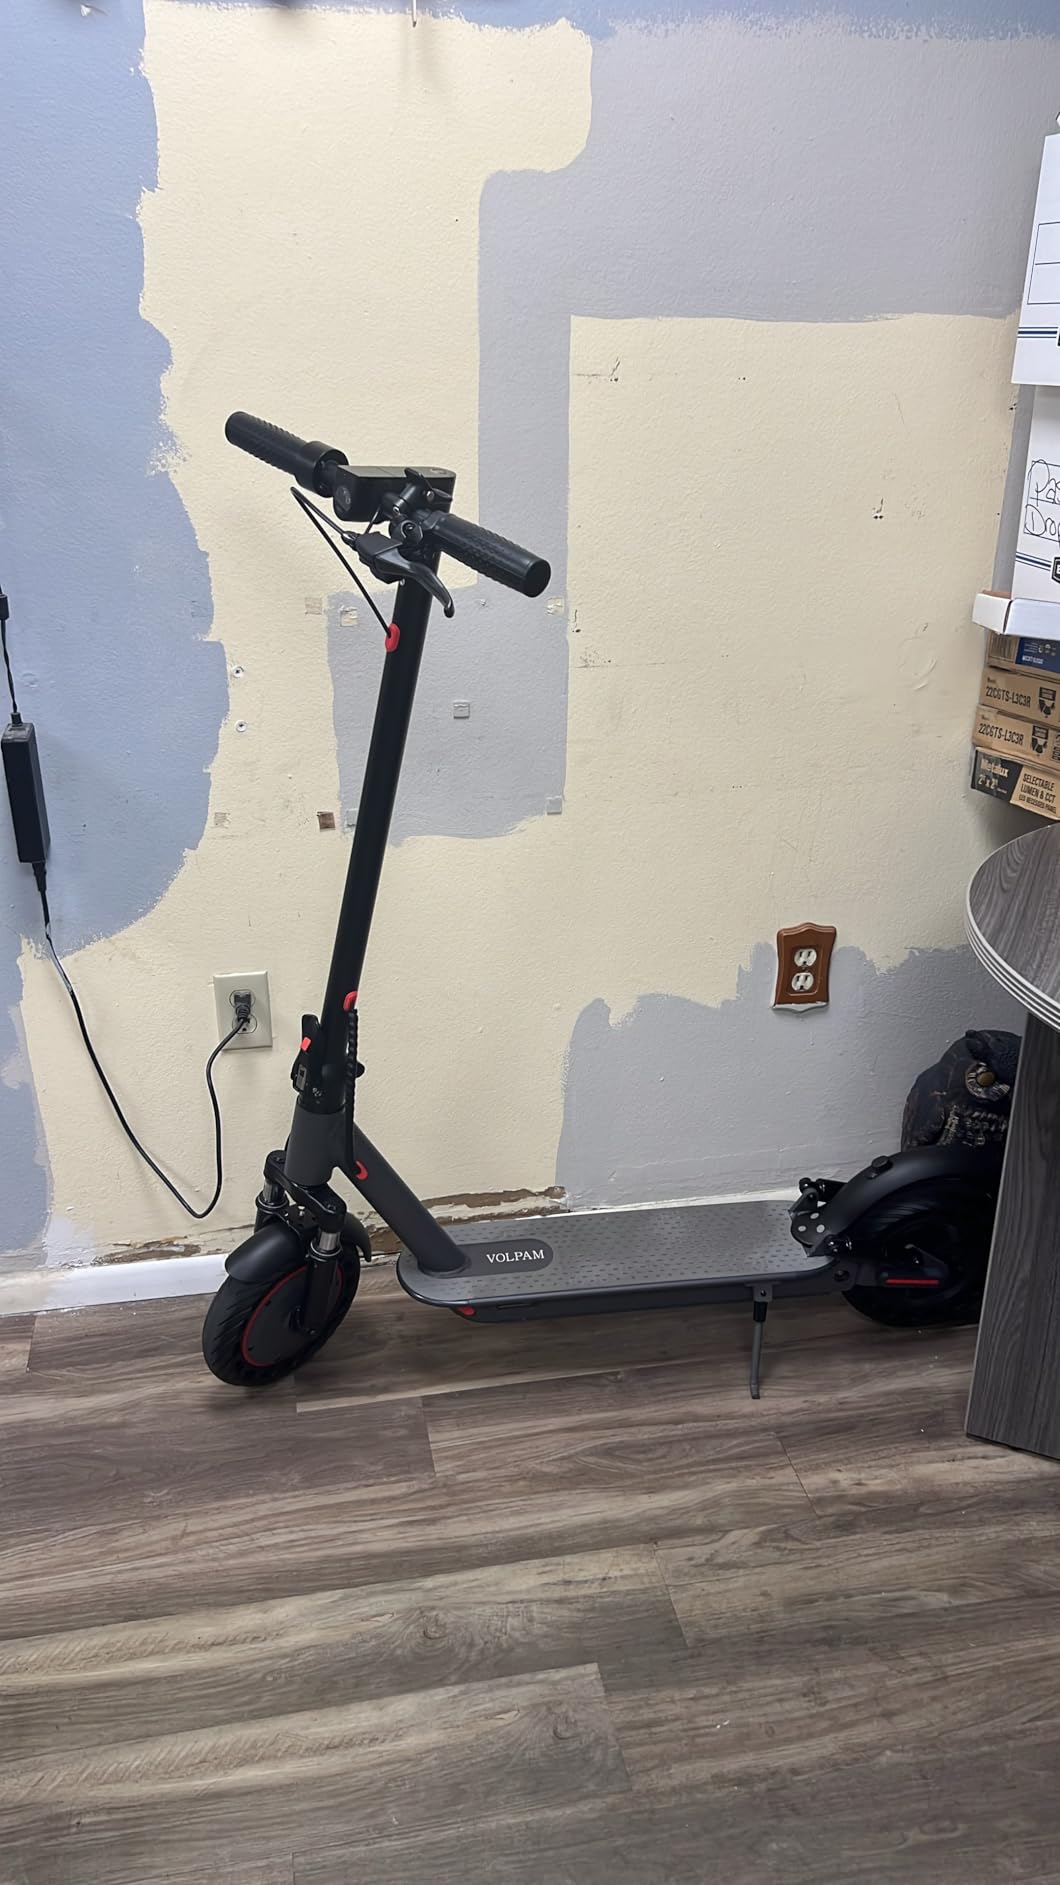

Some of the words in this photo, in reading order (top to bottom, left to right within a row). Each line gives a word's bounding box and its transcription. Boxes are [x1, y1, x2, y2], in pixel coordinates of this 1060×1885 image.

[1022, 773, 1055, 792] SELECTABLE
[1020, 783, 1040, 798] LUMEN
[1039, 790, 1045, 800] &
[1044, 792, 1056, 804] CCT
[485, 1249, 545, 1264] VOLPAM
